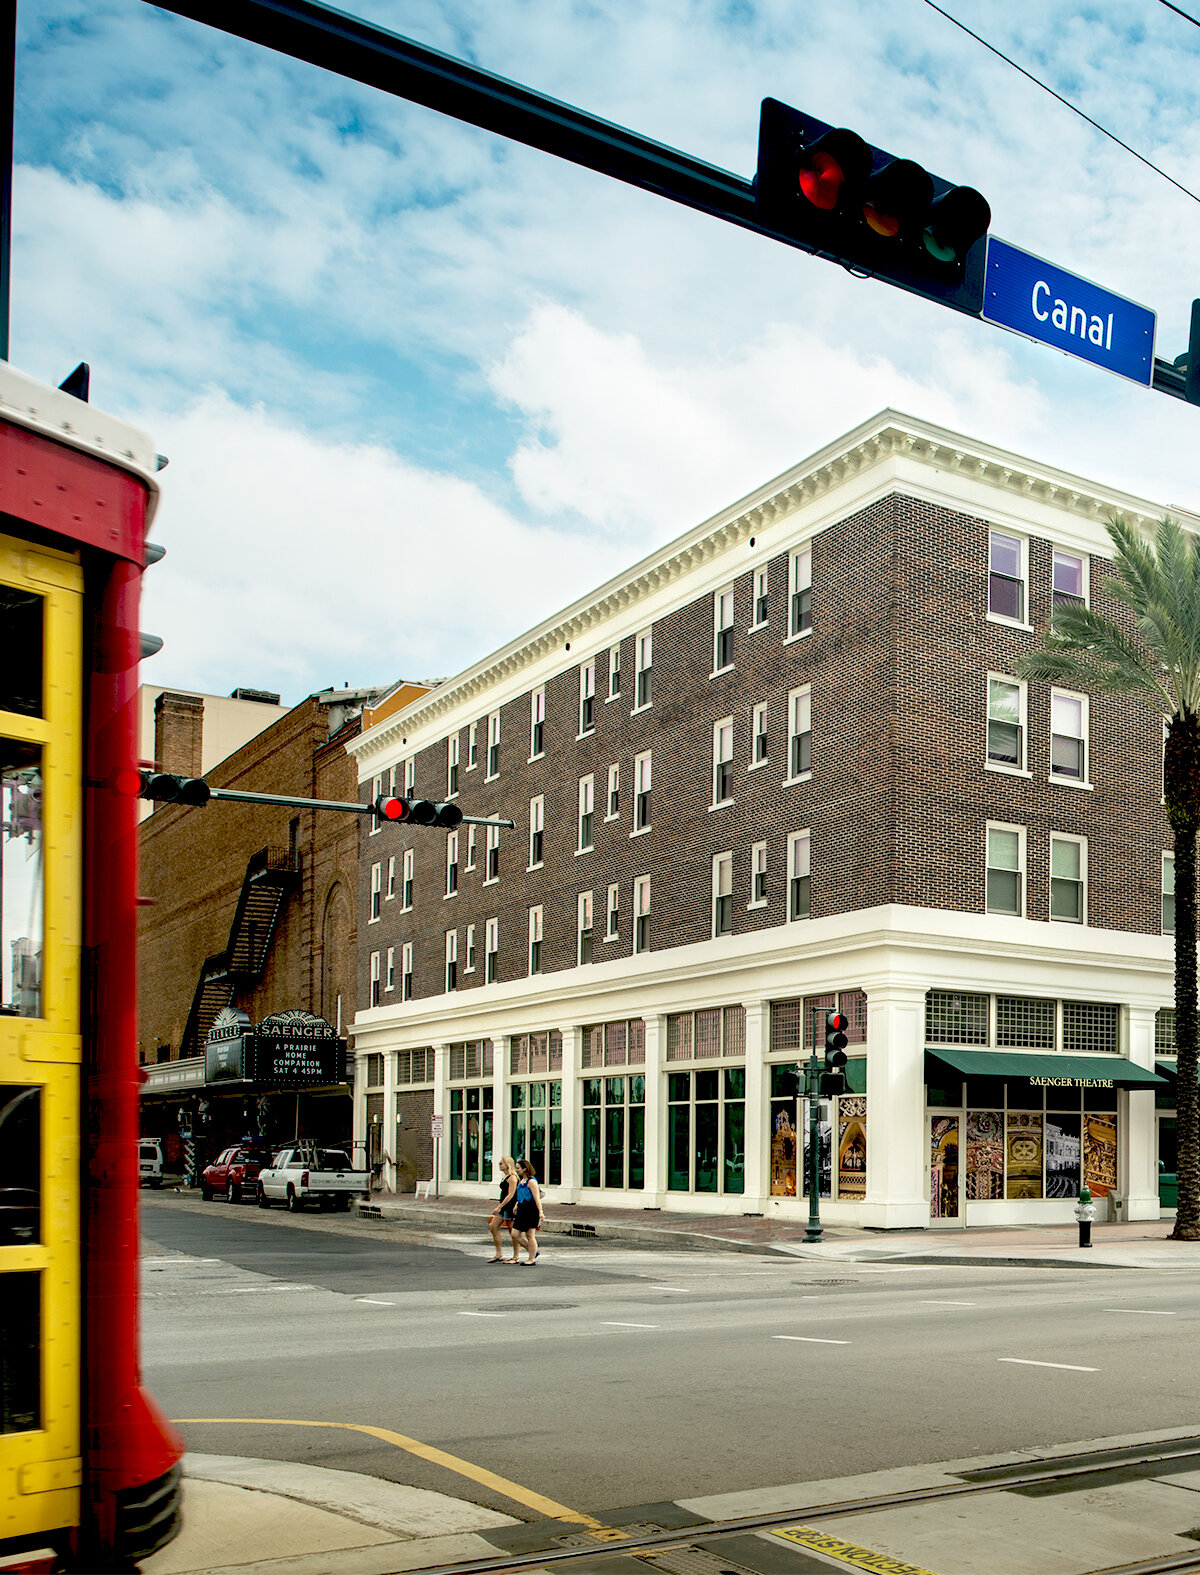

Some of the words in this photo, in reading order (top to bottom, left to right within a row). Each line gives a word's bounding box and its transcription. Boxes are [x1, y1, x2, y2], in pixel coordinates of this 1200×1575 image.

[1031, 280, 1114, 351] Canal
[261, 1024, 333, 1037] SAENGER
[275, 1043, 281, 1051] A
[283, 1043, 317, 1052] PRAIRIE
[285, 1051, 307, 1060] HOME
[273, 1059, 321, 1068] COMPANION
[273, 1066, 289, 1075] SAT
[1029, 1075, 1073, 1087] SAENGER
[1073, 1077, 1114, 1089] THEATRE
[783, 1528, 846, 1549] STOP
[836, 1545, 932, 1575] ECTION
